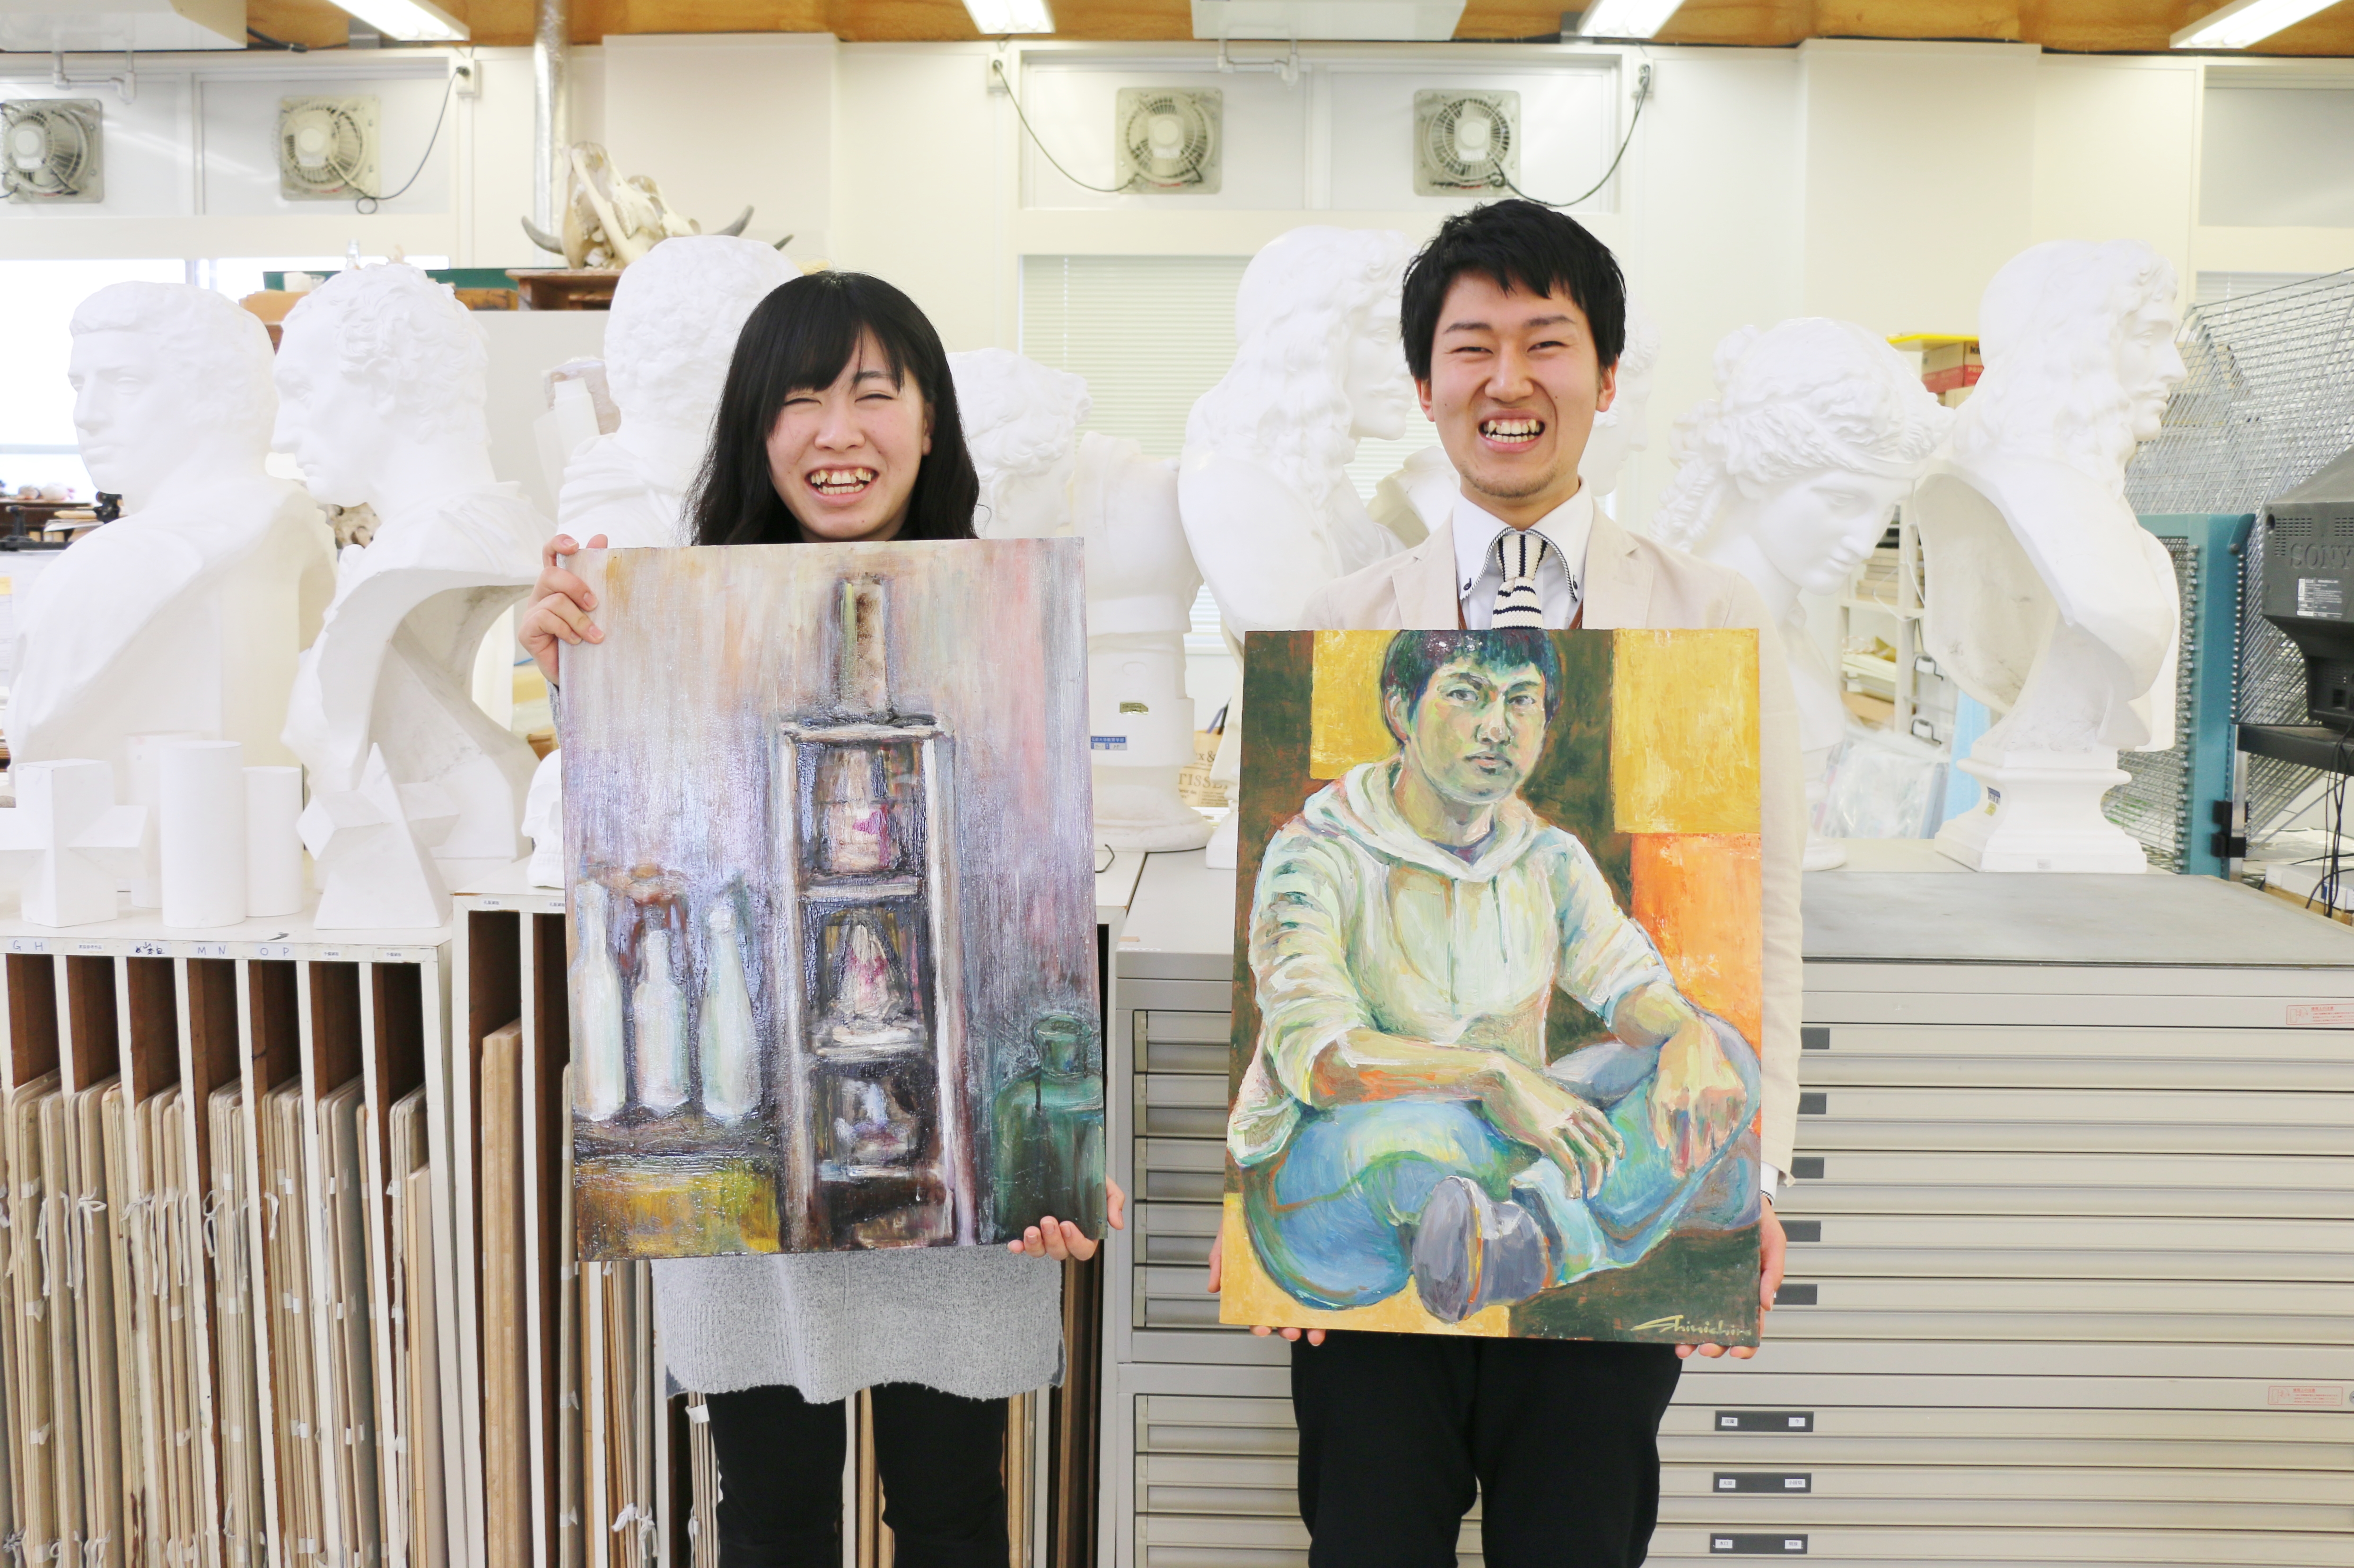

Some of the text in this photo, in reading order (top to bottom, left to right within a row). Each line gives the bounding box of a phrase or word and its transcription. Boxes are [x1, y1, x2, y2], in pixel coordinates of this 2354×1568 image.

[2290, 543, 2354, 569] SONY
[1178, 773, 1228, 789] TISS
[13, 940, 44, 951] G H
[198, 945, 226, 955] M N
[260, 947, 289, 956] O P
